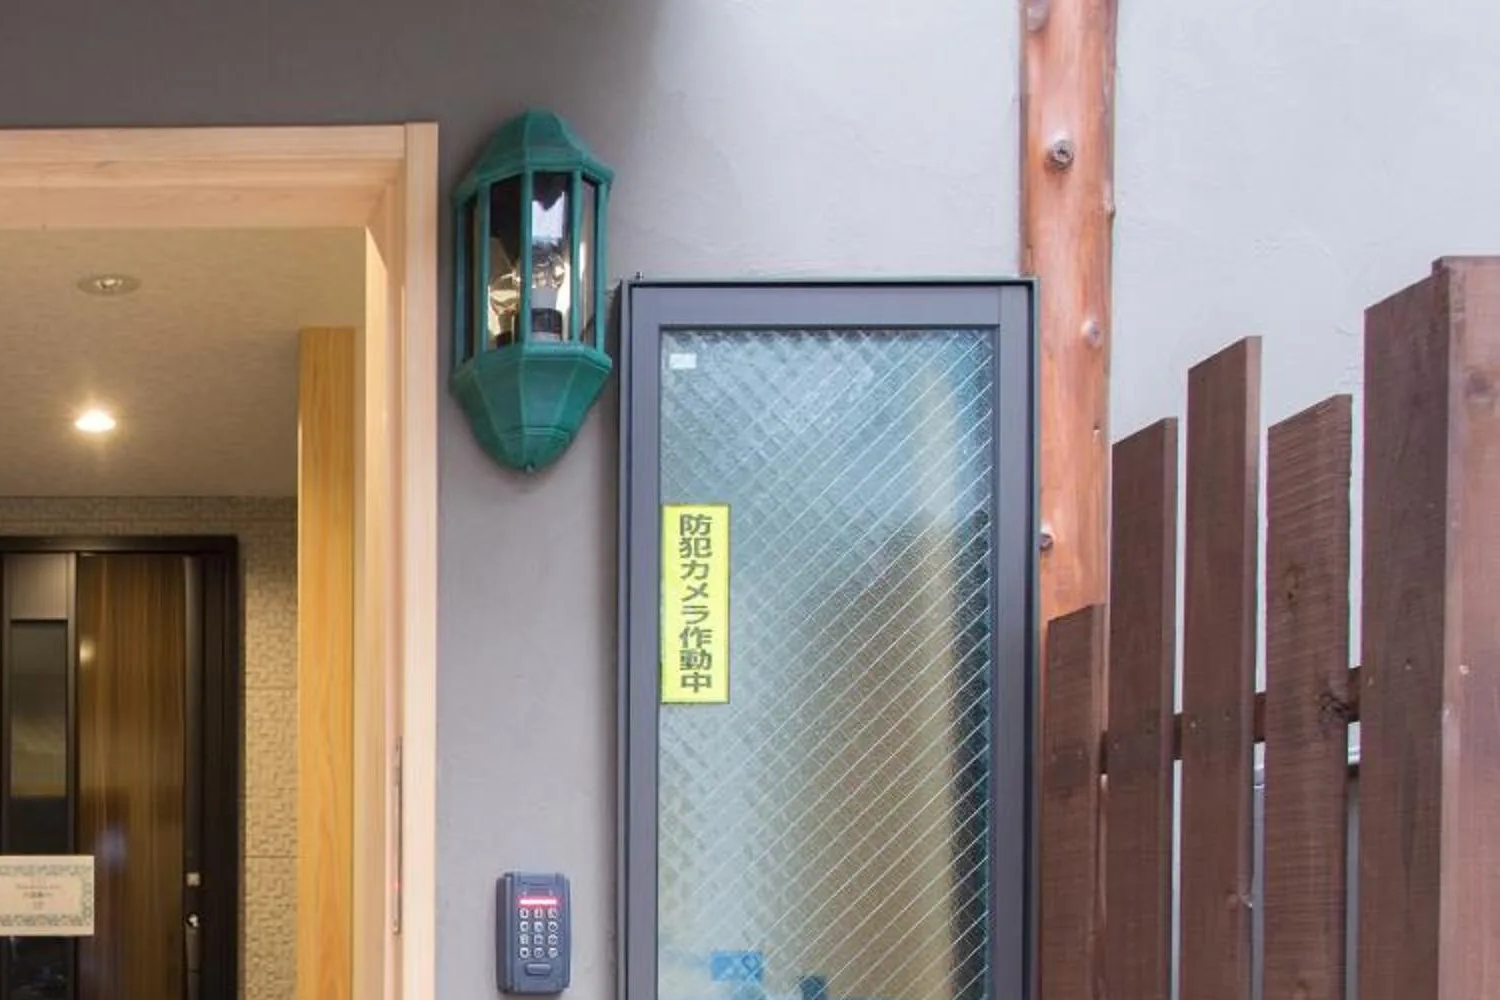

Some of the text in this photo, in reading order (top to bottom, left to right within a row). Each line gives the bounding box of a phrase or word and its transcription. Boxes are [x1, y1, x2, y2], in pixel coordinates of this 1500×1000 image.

[678, 513, 713, 693] 防犯カメラ作動中
